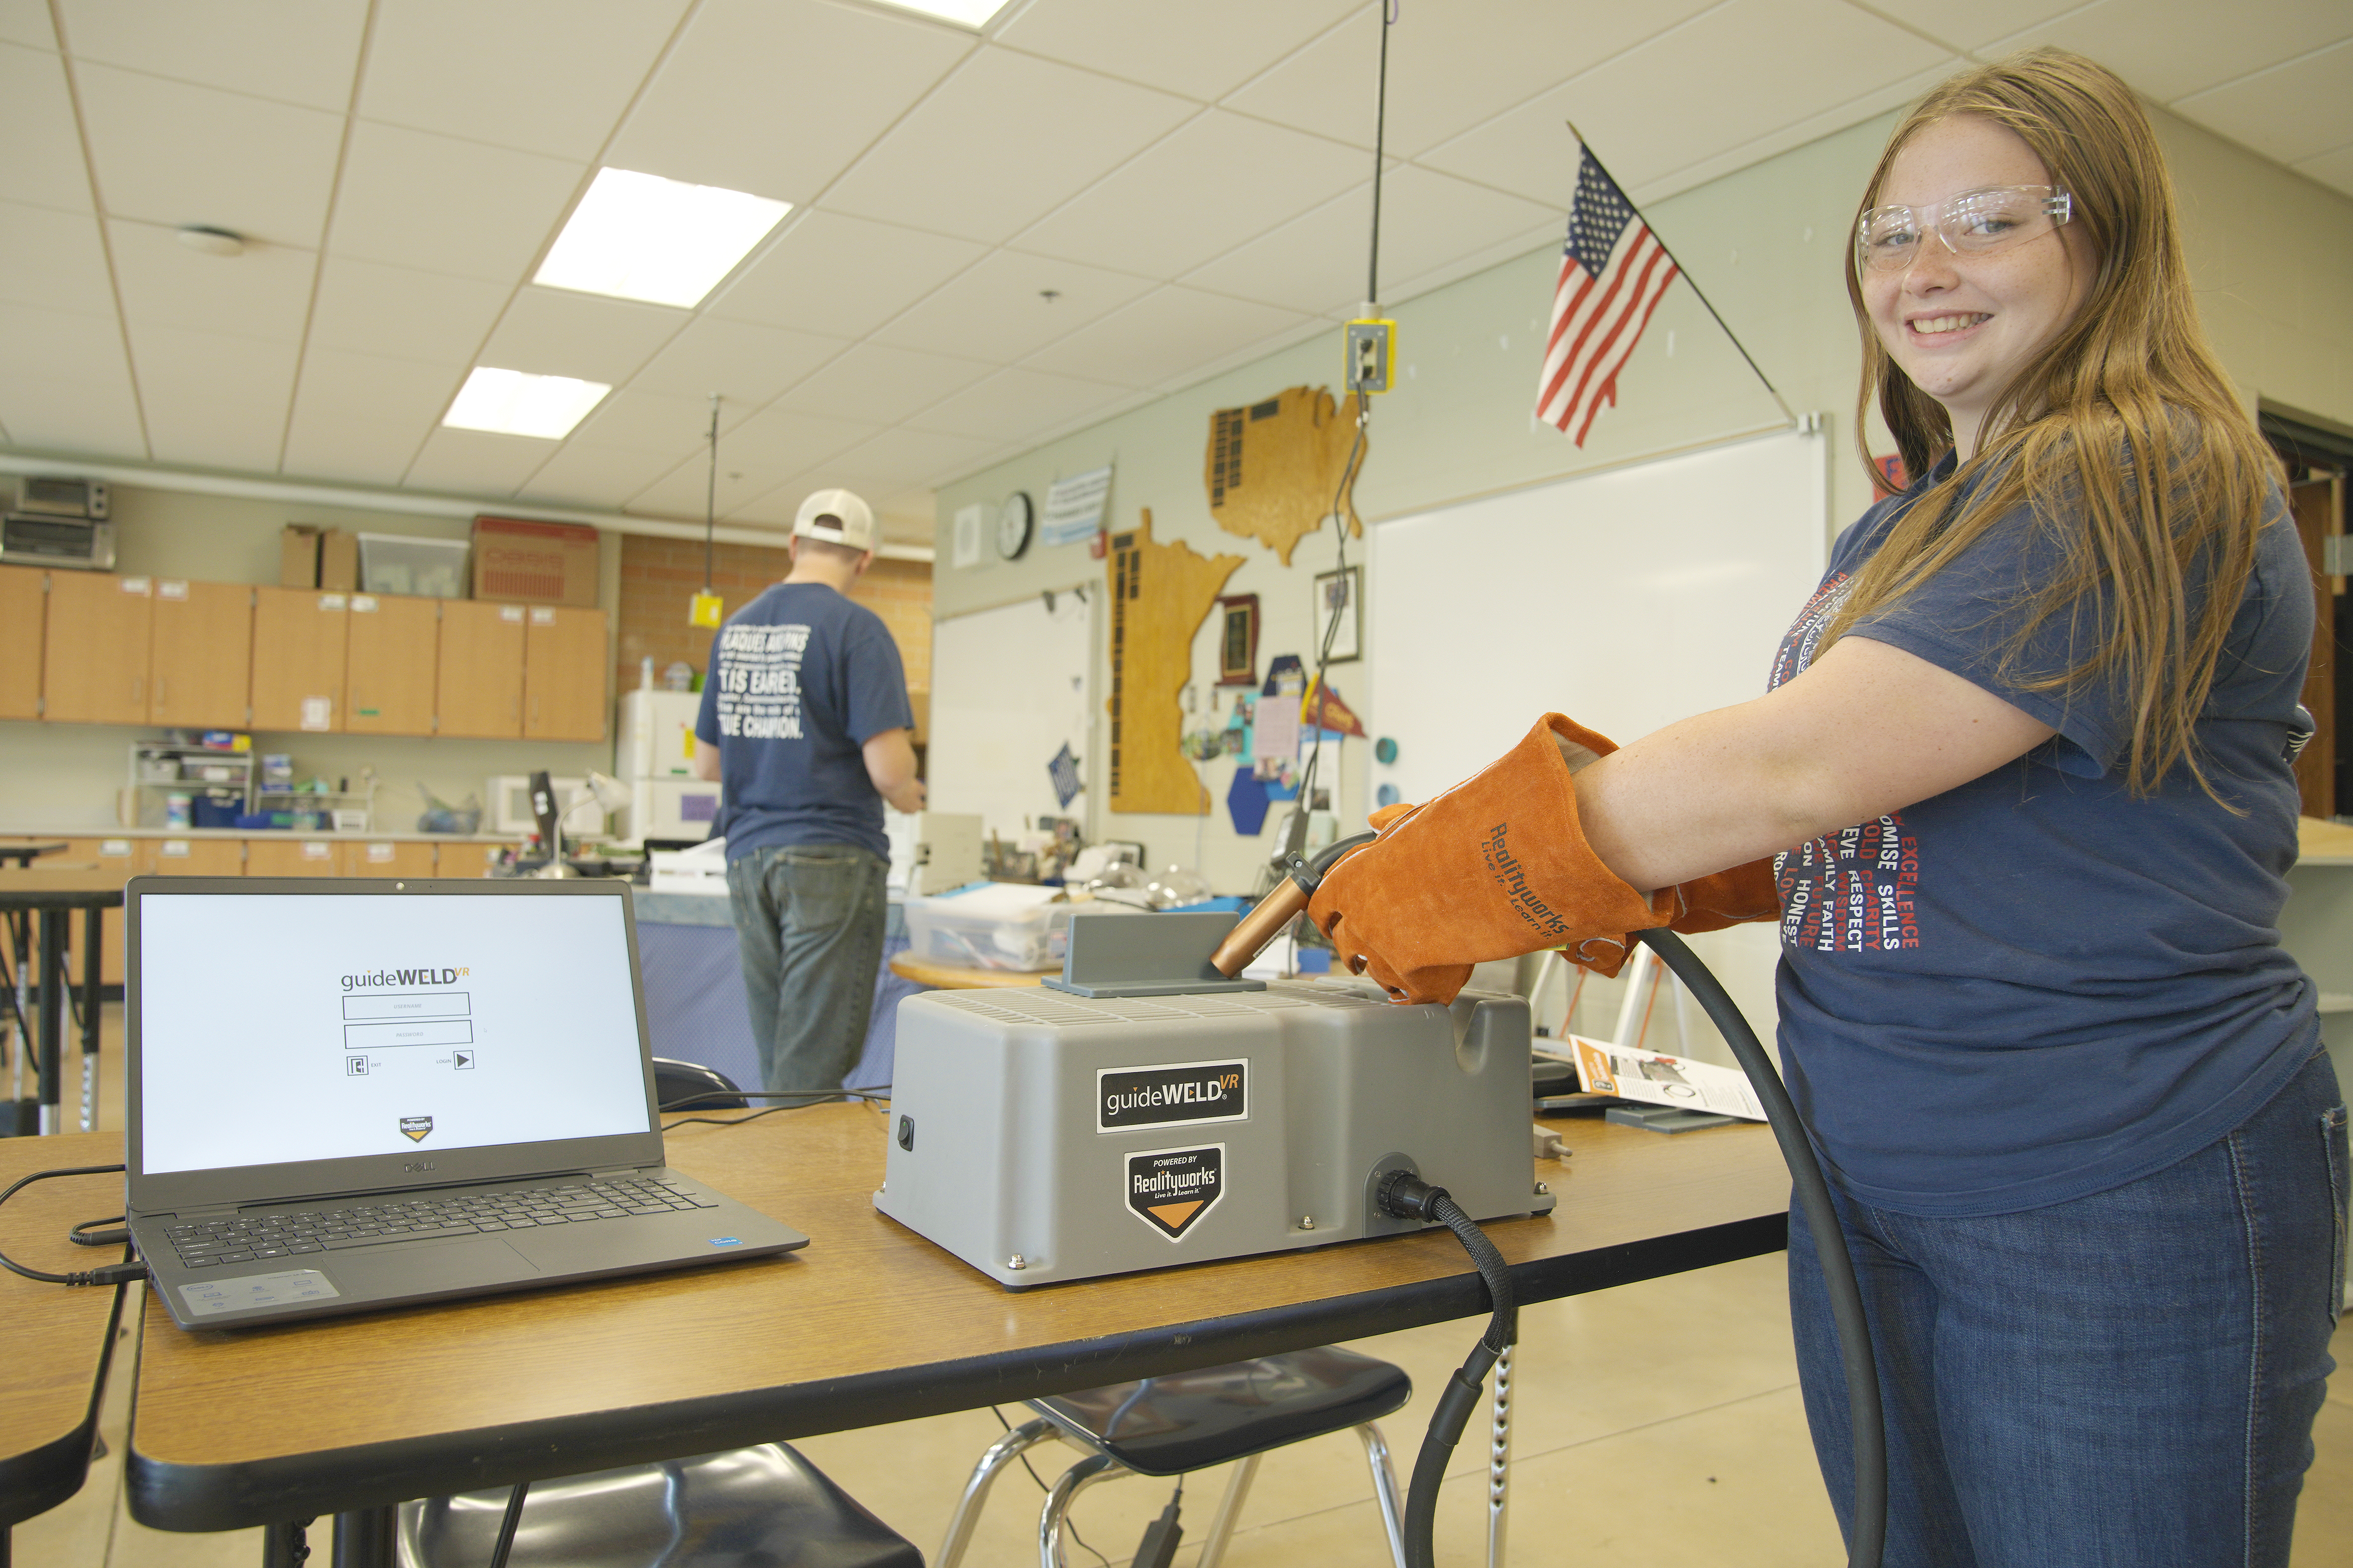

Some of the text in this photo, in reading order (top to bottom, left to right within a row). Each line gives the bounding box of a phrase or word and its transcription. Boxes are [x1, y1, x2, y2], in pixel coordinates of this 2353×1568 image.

[1491, 822, 1570, 934] Realityworks
[1878, 815, 1899, 870] OMISE
[1482, 841, 1553, 939] Live it. Learn it.
[1778, 868, 1799, 912] LOYA
[1786, 841, 1812, 947] ON HONEST
[1799, 840, 1824, 947] UE FUTURE
[1817, 835, 1836, 951] AMILY FAITH
[1824, 830, 1850, 952] AGE WISDOM
[1840, 824, 1863, 952] EVE RESPECT
[1859, 869, 1881, 951] CHARITY
[1878, 885, 1900, 950] SKILLS
[1896, 836, 1919, 948] EXCELLENCE
[401, 1121, 432, 1129] Realityworks
[405, 1161, 437, 1173] DELL
[1153, 1156, 1187, 1167] POWERED
[1134, 1167, 1215, 1196] Realityworks
